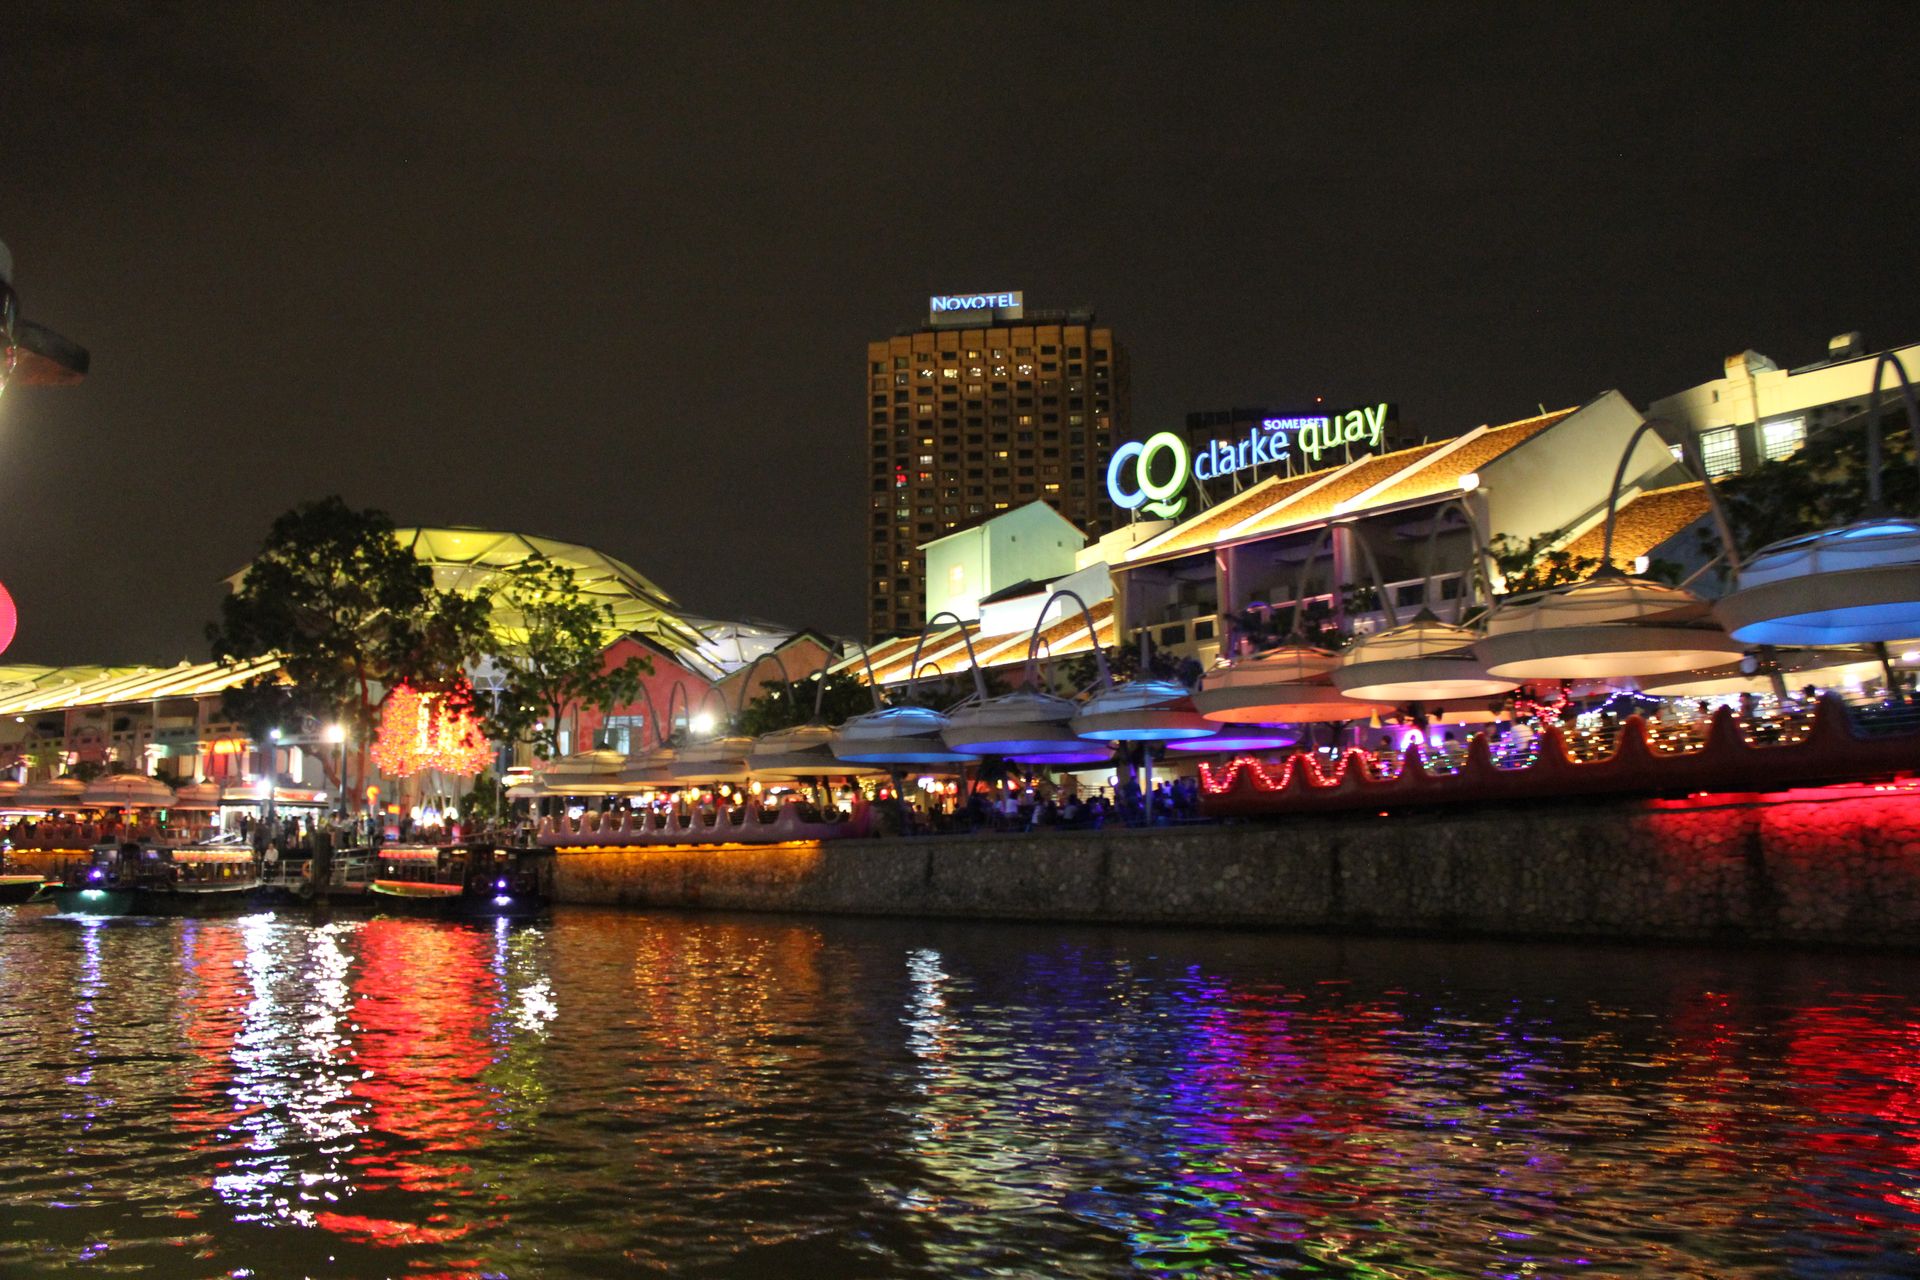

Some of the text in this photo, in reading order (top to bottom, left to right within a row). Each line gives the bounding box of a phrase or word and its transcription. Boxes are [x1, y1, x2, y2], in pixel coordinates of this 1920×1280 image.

[932, 291, 1019, 311] NOVOTEL
[1195, 428, 1290, 480] clarke
[1298, 403, 1388, 461] quay
